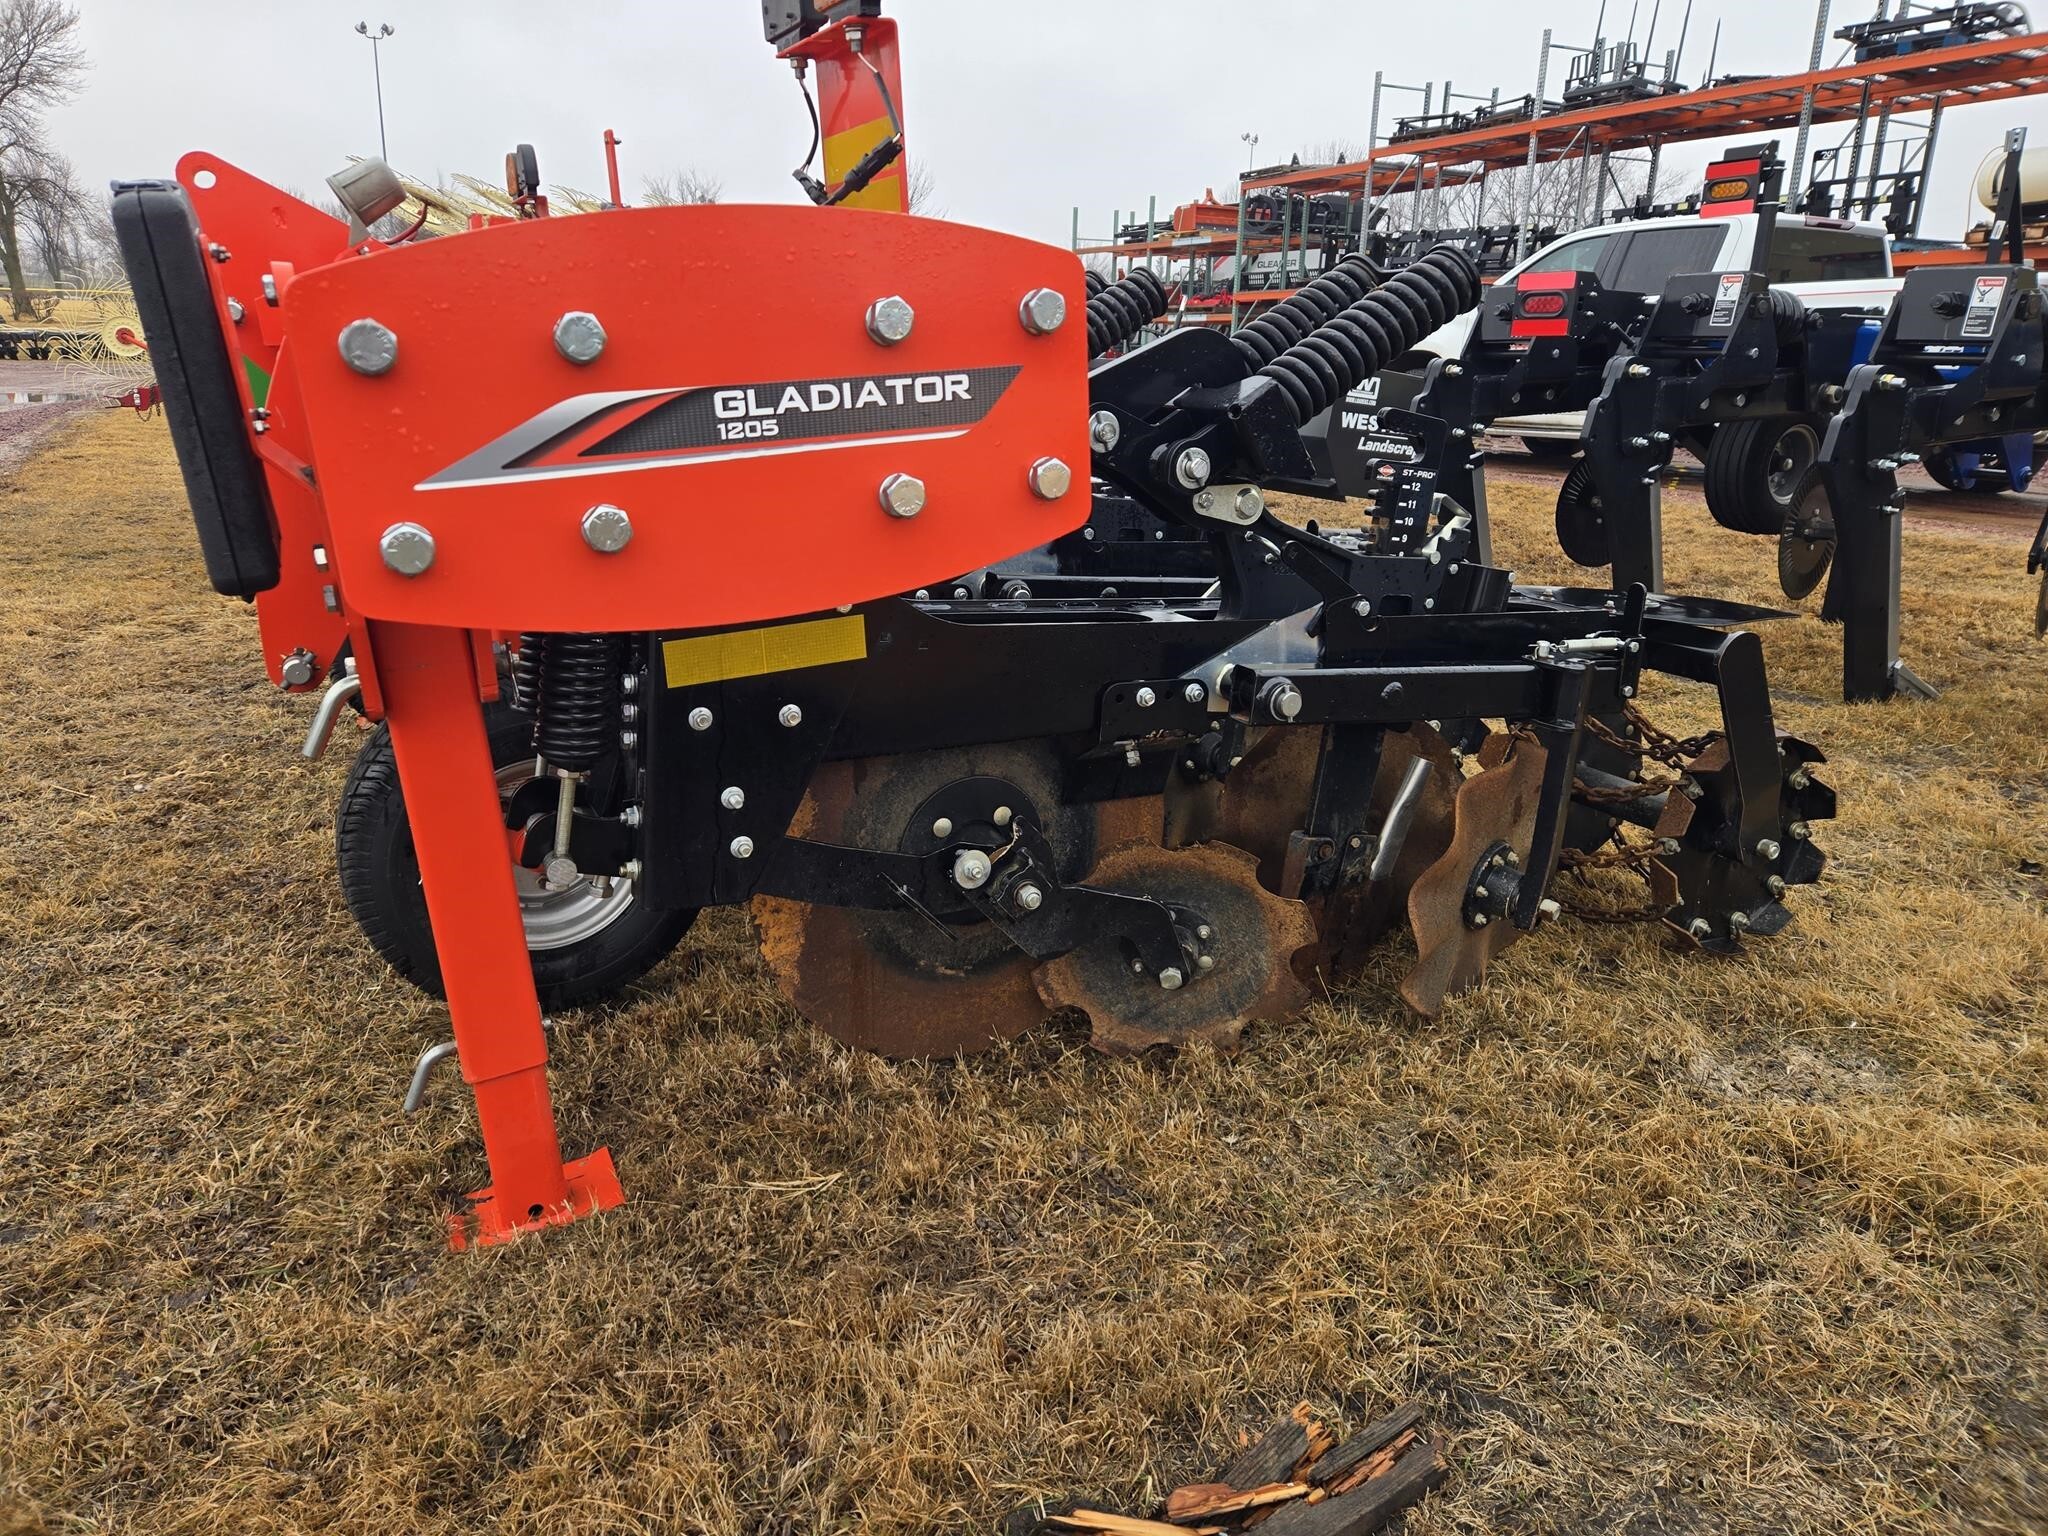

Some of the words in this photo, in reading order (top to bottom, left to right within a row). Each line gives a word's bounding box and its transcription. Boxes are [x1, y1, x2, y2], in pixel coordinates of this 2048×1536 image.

[1257, 259, 1297, 269] GLEAER
[713, 373, 972, 419] GLADIATOR
[716, 418, 779, 440] 1205
[1411, 482, 1421, 491] 12
[1407, 500, 1417, 509] 11
[1404, 517, 1414, 526] 10
[1401, 534, 1408, 543] 9
